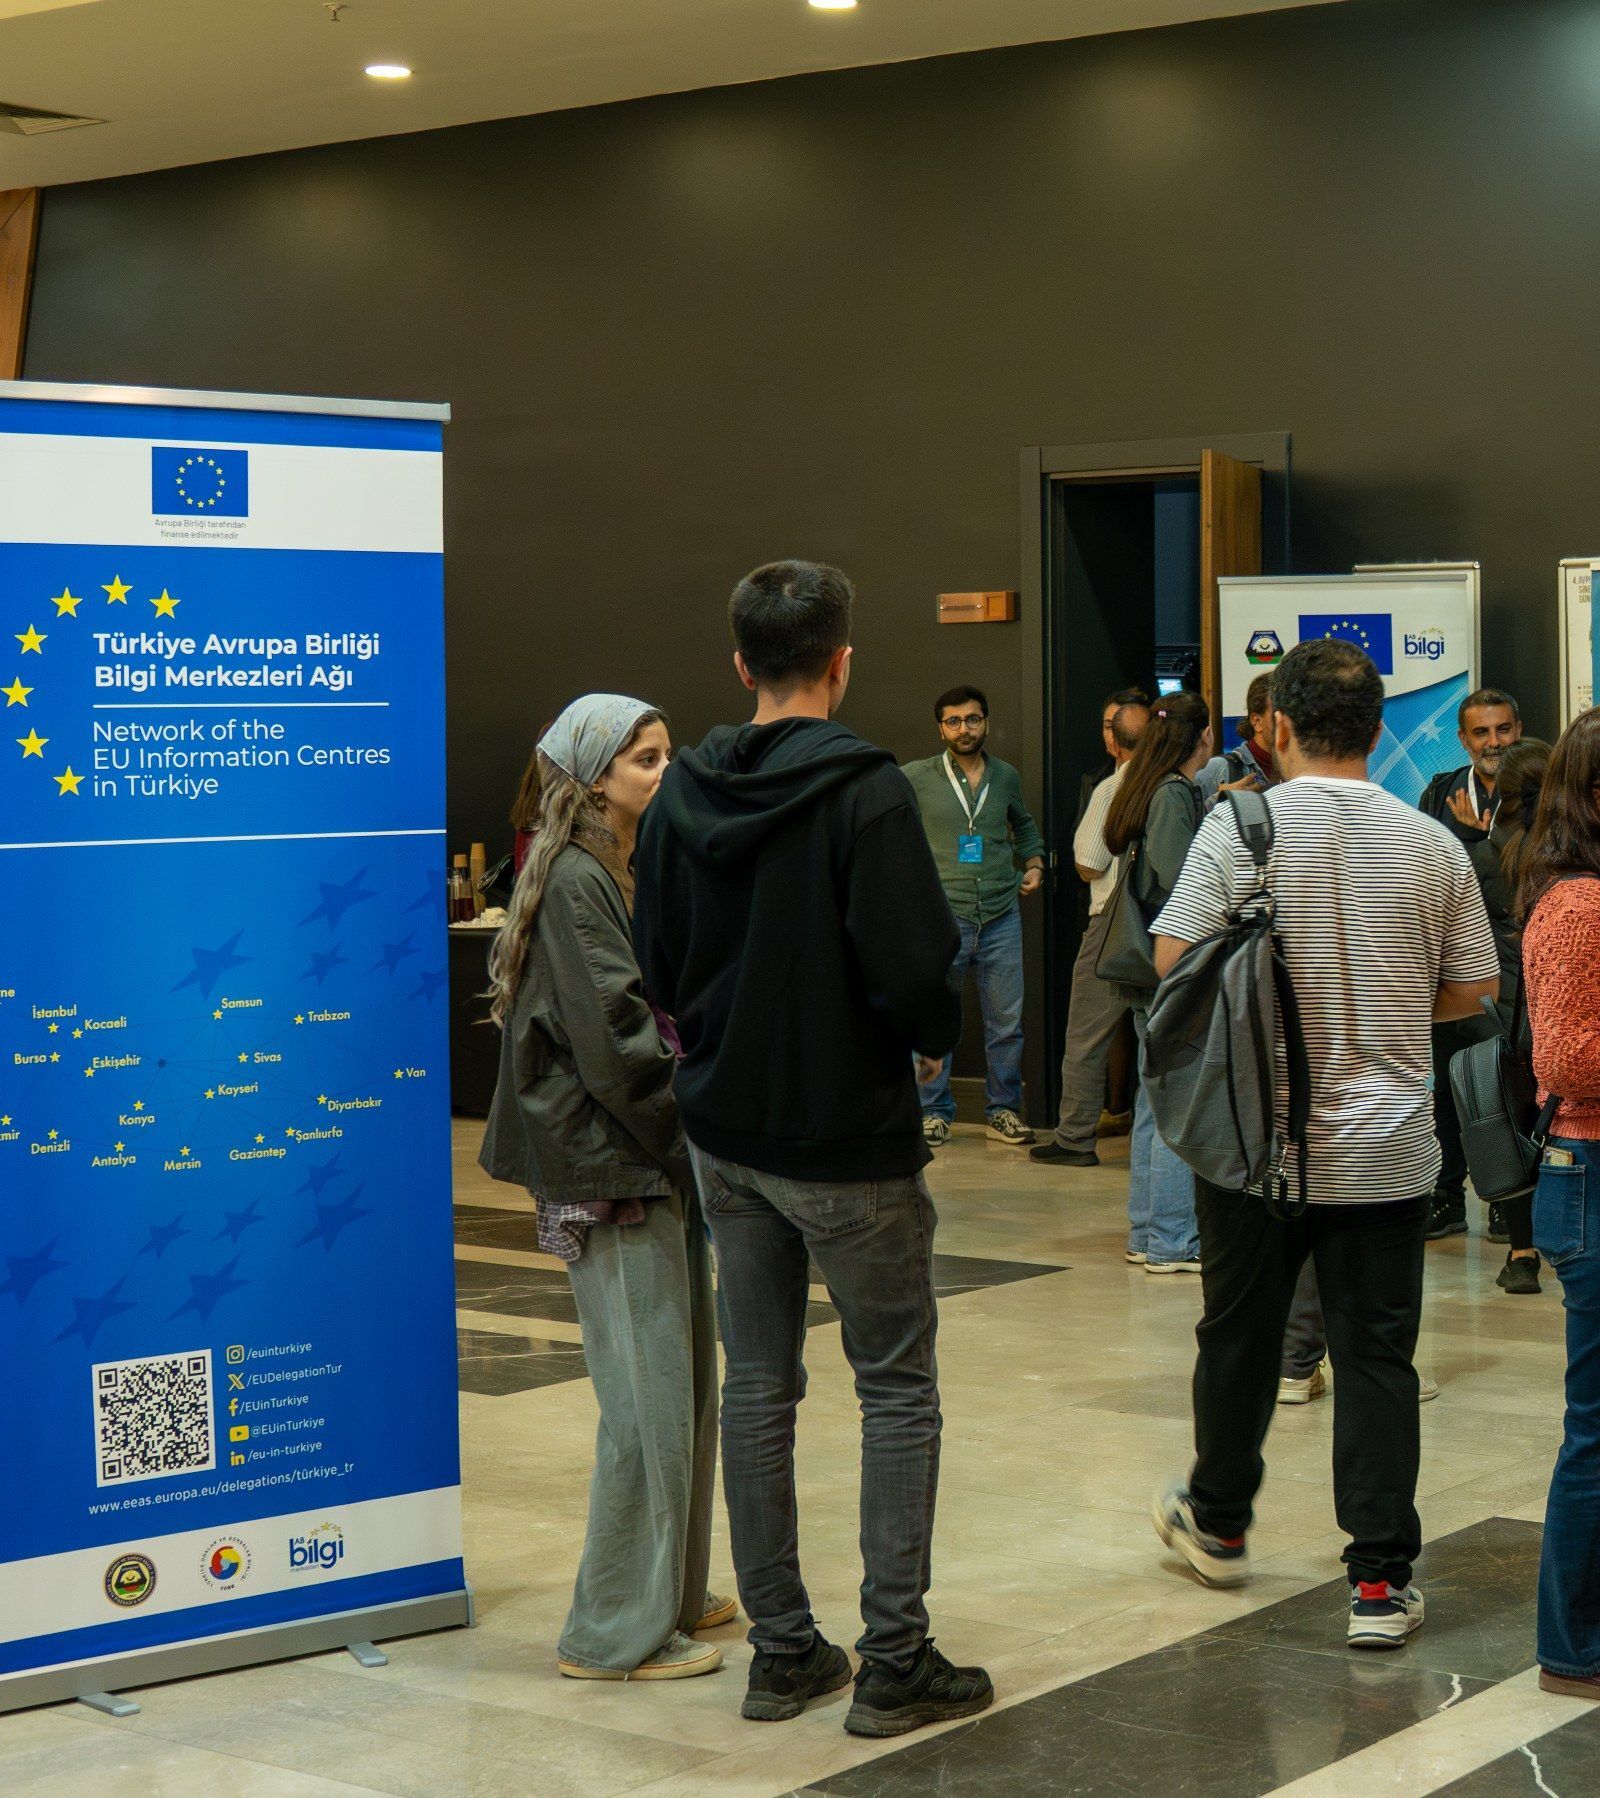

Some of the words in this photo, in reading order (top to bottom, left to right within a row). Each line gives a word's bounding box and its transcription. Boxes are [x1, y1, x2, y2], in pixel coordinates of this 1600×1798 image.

[155, 518, 182, 528] Avrupa
[160, 530, 189, 538] finanse
[191, 530, 239, 539] edilmektedir
[93, 633, 196, 660] Türkiye
[203, 633, 298, 659] Avrupa
[305, 632, 380, 661] Birliği
[1404, 634, 1445, 661] bilgi
[95, 664, 156, 692] Bilgi
[165, 664, 303, 688] Merkezleri
[309, 664, 353, 692] Ağı
[93, 719, 204, 743] Network
[211, 718, 237, 740] of
[242, 718, 285, 740] the
[94, 748, 129, 770] EU
[139, 745, 290, 768] Information
[297, 743, 391, 766] Centres
[93, 776, 117, 797] in
[125, 774, 219, 800] Türkiye
[221, 997, 263, 1009] Samsun
[32, 1004, 77, 1019] İstanbul
[307, 1010, 351, 1022] Trabzon
[84, 1016, 127, 1030] Kocaeli
[14, 1053, 47, 1065] Bursa
[92, 1055, 141, 1070] Eskişehir
[253, 1053, 282, 1063] Sivas
[406, 1067, 426, 1078] Van
[217, 1082, 259, 1097] Kayseri
[327, 1096, 383, 1112] Diyarbakır
[119, 1114, 155, 1127] Konya
[295, 1126, 343, 1143] Şanlıurfa
[31, 1140, 70, 1155] Denizli
[229, 1148, 286, 1161] Gaziantep
[91, 1153, 136, 1168] Antalya
[163, 1159, 201, 1171] Mersin
[247, 1341, 312, 1361] /euinturkiye
[246, 1363, 342, 1388] /EUDelegationTur
[239, 1394, 309, 1415] /EUinTurkiye
[251, 1416, 325, 1438] @EUinTurkiye
[247, 1440, 322, 1462] /eu-in-turkiye
[289, 1533, 344, 1569] bilgi
